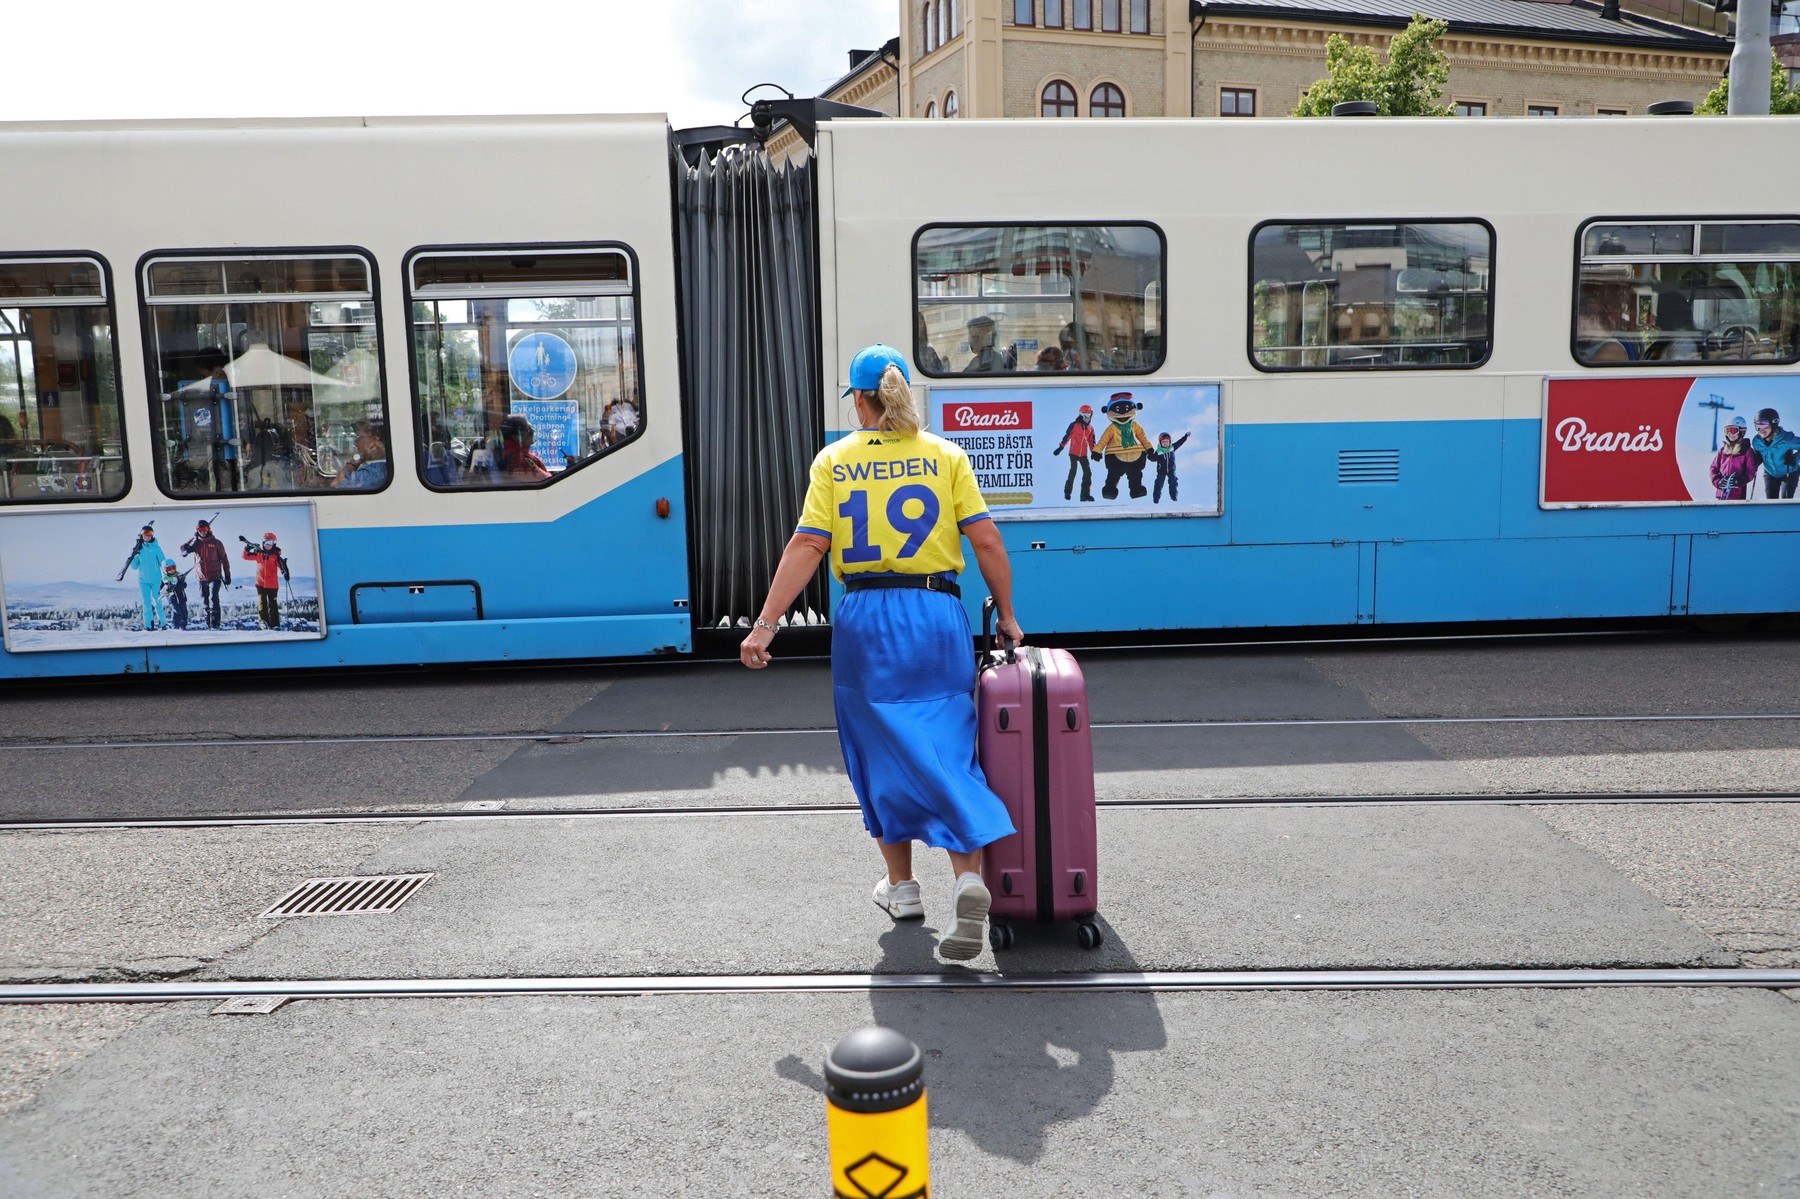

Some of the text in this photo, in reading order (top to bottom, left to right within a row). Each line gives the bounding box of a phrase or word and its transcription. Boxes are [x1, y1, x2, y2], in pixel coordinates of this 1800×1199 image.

[512, 405, 576, 413] Cykelparkering
[955, 406, 1020, 427] Branäs
[945, 434, 1033, 450] VERIGES BÄSTA
[1555, 416, 1663, 452] Branäs
[833, 458, 938, 482] SWEDEN
[969, 450, 1033, 470] DORT FÖR
[974, 472, 1033, 488] FAMILJER
[838, 484, 940, 564] 19
